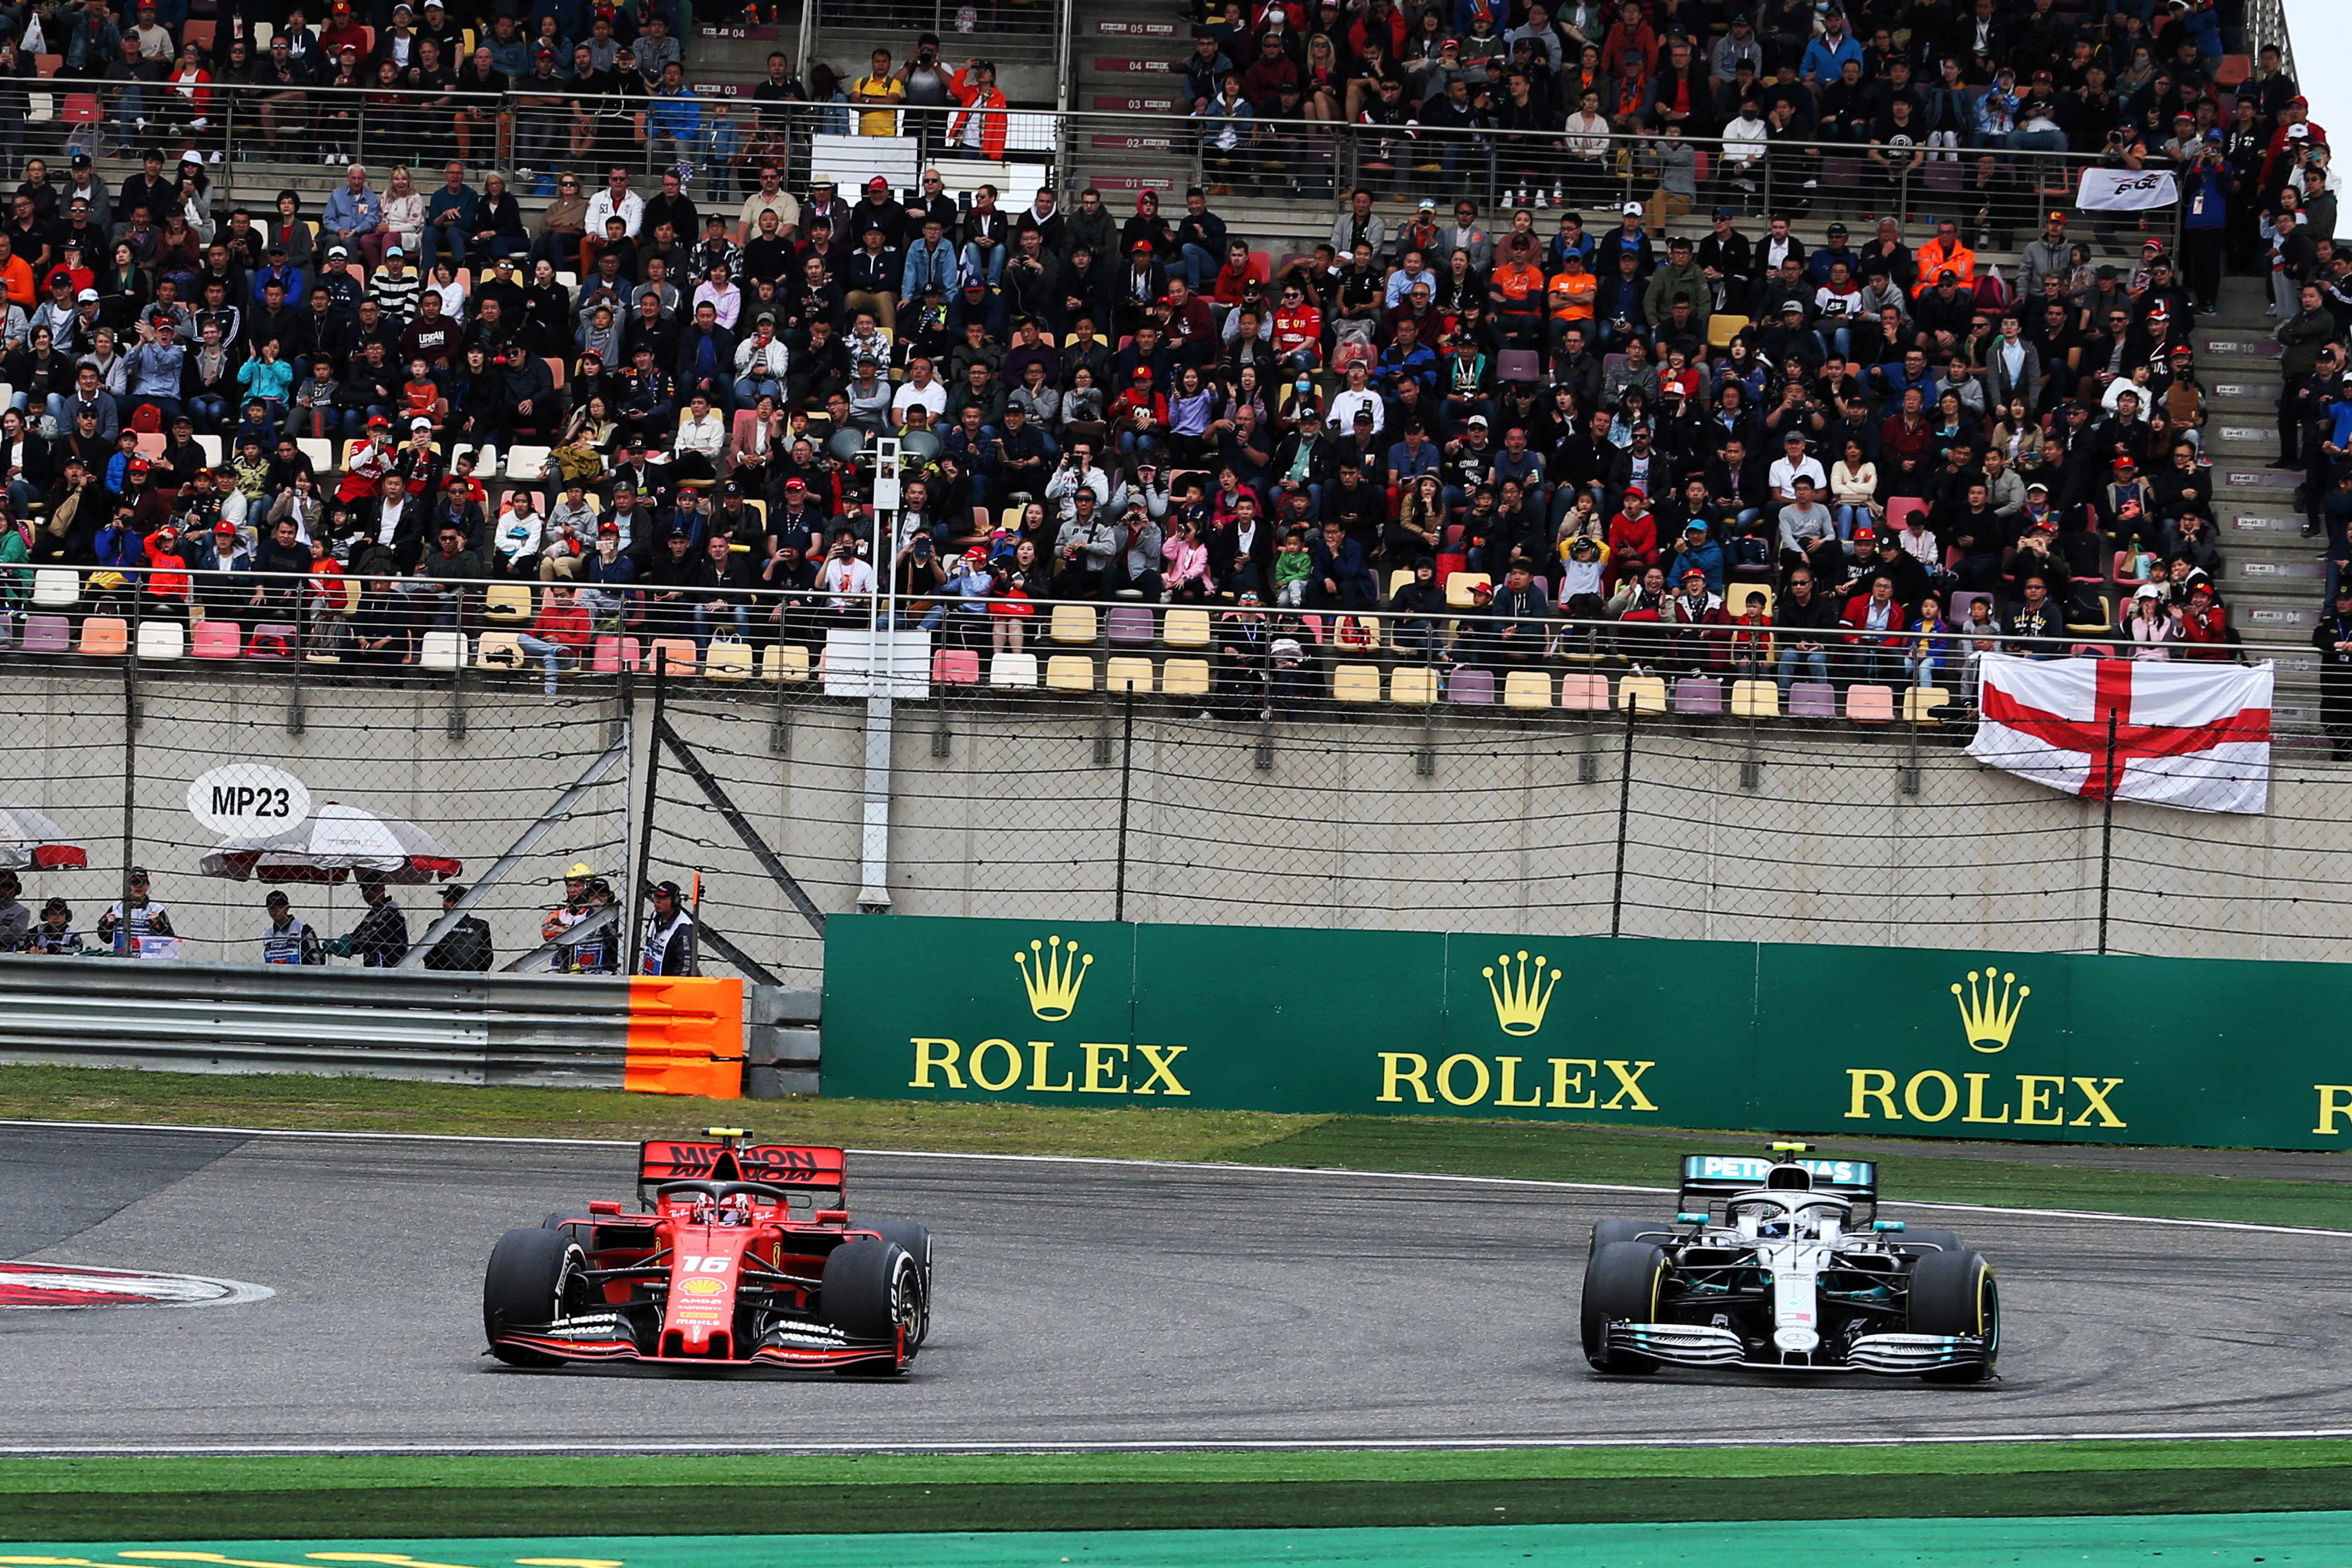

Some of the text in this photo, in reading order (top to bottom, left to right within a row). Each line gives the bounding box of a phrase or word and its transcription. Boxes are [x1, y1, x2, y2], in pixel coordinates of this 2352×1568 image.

[733, 29, 745, 38] 04
[1131, 24, 1143, 33] 05
[1130, 62, 1142, 70] 04
[725, 86, 737, 94] 03
[1128, 100, 1140, 109] 03
[1127, 139, 1139, 147] 02
[2242, 344, 2254, 353] 10
[2287, 612, 2300, 622] 04
[212, 786, 289, 817] MP23
[908, 1038, 1191, 1095] ROLEX
[1376, 1052, 1658, 1111] ROLEX
[1844, 1069, 2127, 1128] ROLEX
[682, 1255, 733, 1273] 16
[552, 1313, 617, 1327] MISSION
[547, 1325, 615, 1335] WINNOW
[779, 1320, 845, 1337] MISSION
[779, 1332, 847, 1345] WINNOW
